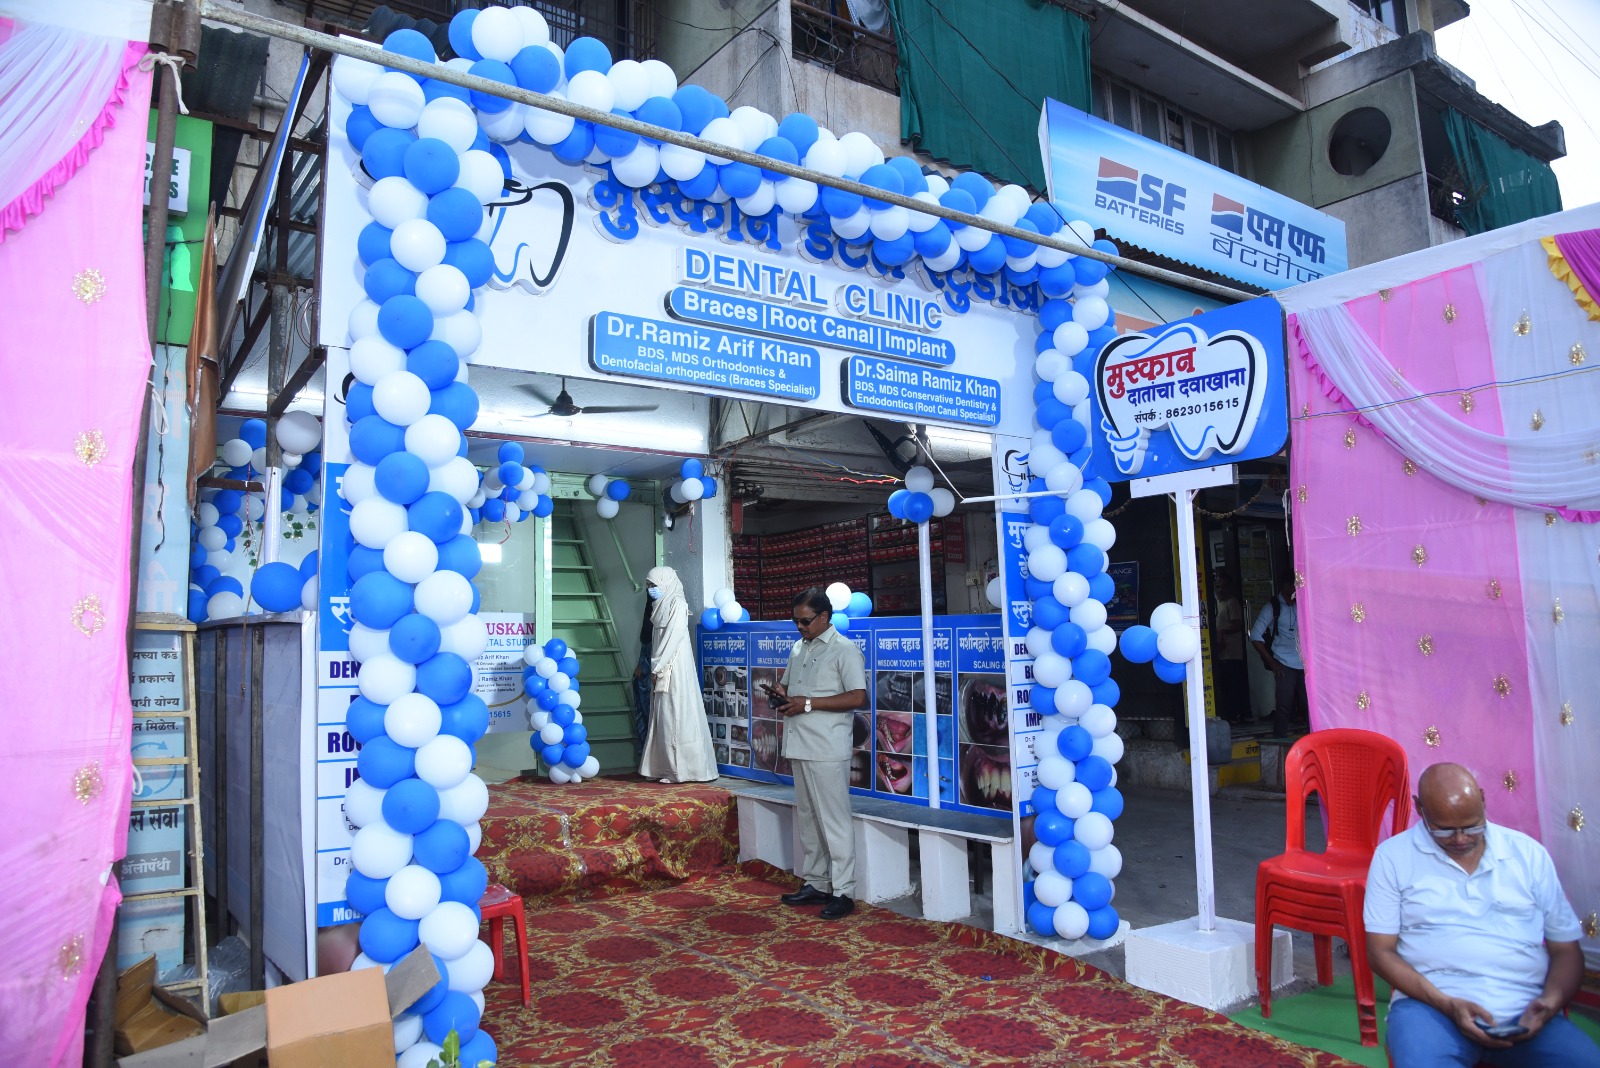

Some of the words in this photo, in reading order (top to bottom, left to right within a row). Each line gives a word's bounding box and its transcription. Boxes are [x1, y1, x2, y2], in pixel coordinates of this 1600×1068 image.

[1095, 193, 1185, 236] BATTERIES
[1138, 173, 1187, 216] SF
[685, 247, 829, 306] DENTAL
[844, 283, 943, 330] CLINIC
[607, 316, 711, 351] Dr.Ramiz
[717, 335, 756, 358] Arif
[761, 342, 812, 368] Khan
[684, 291, 758, 321] Braces
[770, 308, 817, 334] Root
[822, 317, 874, 344] Canal
[885, 331, 947, 359] Implant
[601, 354, 663, 374] Dentofacial
[665, 364, 727, 386] orthopedics
[729, 373, 766, 389] (Braces
[768, 379, 816, 398] Specialist)
[637, 346, 669, 362] BDS,
[672, 351, 699, 365] MDS
[702, 357, 775, 378] Orthodontics
[779, 368, 787, 379] &
[855, 358, 919, 386] Dr.Saima
[922, 370, 962, 393] Ramiz
[965, 377, 997, 399] Khan
[1105, 347, 1197, 399] मुस्कान
[854, 380, 877, 394] BDS,
[879, 384, 899, 397] MDS
[901, 388, 954, 405] Conservative
[955, 396, 990, 413] Dentistry
[991, 403, 997, 412] &
[1126, 381, 1176, 407] दातांचा
[1178, 367, 1247, 398] दवाखाना
[856, 393, 914, 411] Endodontics
[915, 401, 936, 414] (Root
[937, 404, 959, 417] Canal
[959, 407, 996, 424] Specialist)
[1165, 397, 1239, 419] 8623015615
[486, 622, 535, 635] USKAN
[486, 638, 504, 647] TAL
[131, 650, 158, 661] मच्या
[489, 710, 512, 718] 15615
